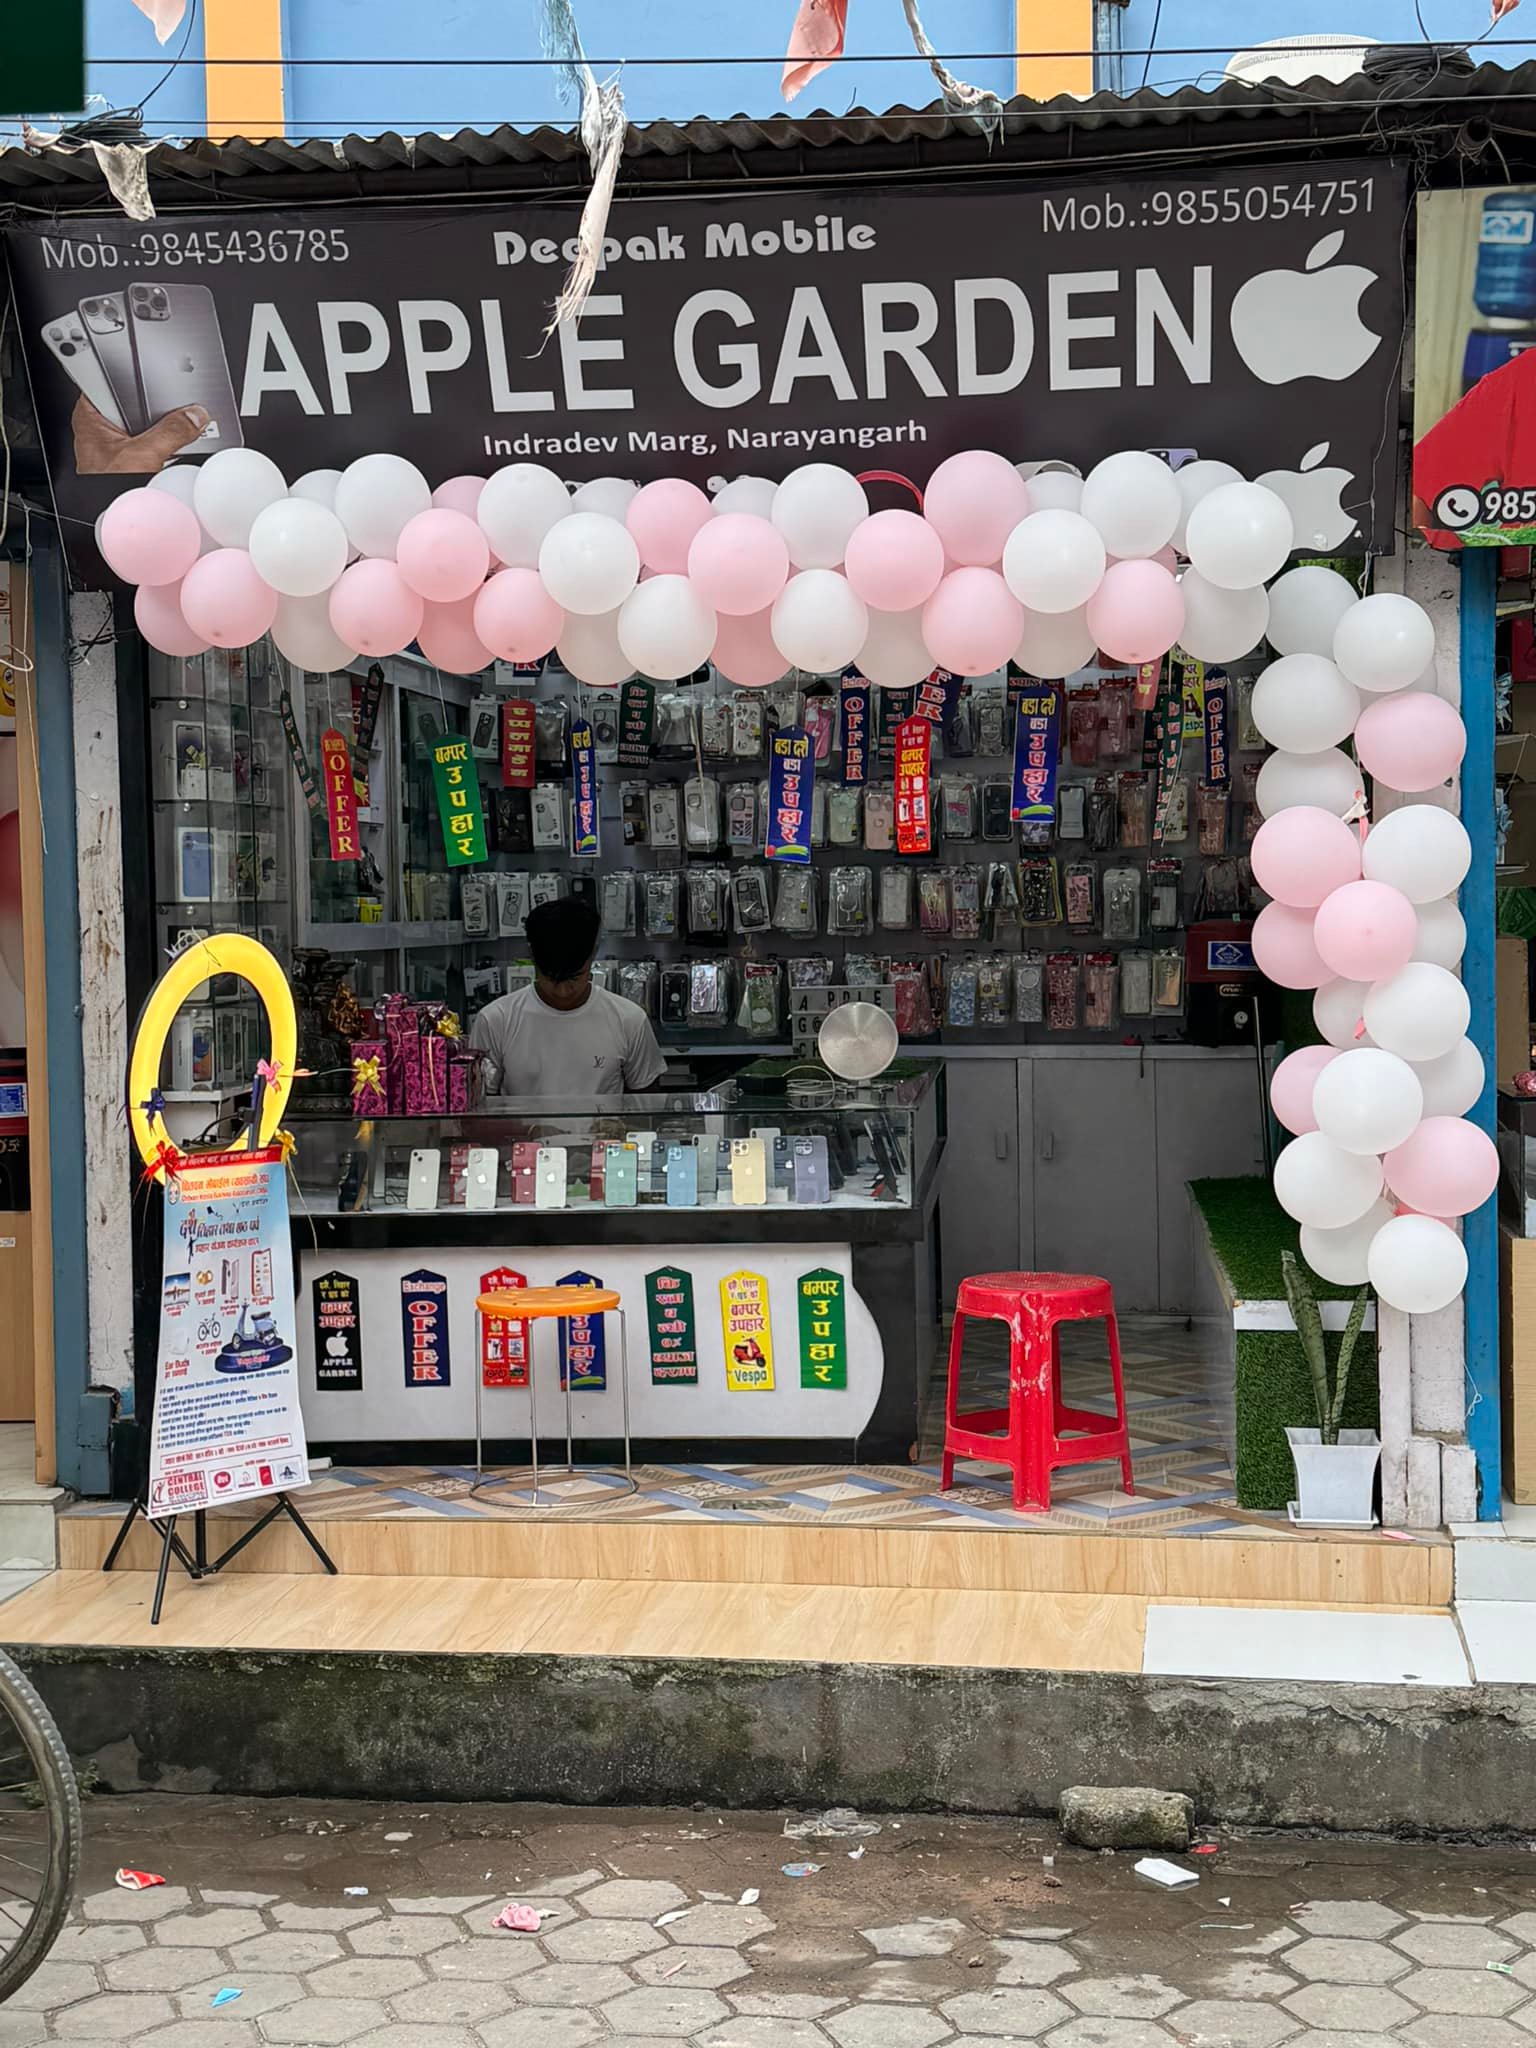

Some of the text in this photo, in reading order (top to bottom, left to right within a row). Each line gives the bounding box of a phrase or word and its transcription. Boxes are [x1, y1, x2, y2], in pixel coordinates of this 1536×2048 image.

[1043, 178, 1375, 235] Mob.:9855054751
[705, 214, 877, 259] Mobile
[238, 265, 1214, 417] APPLE GARDEN
[483, 419, 928, 457] Indradev Marg, Narayangarh
[844, 696, 865, 782] OFFER
[1207, 697, 1226, 781] OFFER
[434, 742, 468, 764] बम्पर
[329, 754, 355, 854] OFFER
[402, 1280, 447, 1294] Exchange
[801, 1280, 840, 1296] बम्पर
[730, 1303, 761, 1317] बम्पर
[729, 1318, 765, 1332] उपहार
[408, 1300, 442, 1381] OFFER
[808, 1299, 838, 1382] उपहार
[322, 1358, 353, 1366] APPLE
[318, 1369, 358, 1378] GARDEN
[733, 1369, 768, 1386] Vespa
[166, 1471, 204, 1487] CENTRAL
[166, 1482, 205, 1497] COLLEGE
